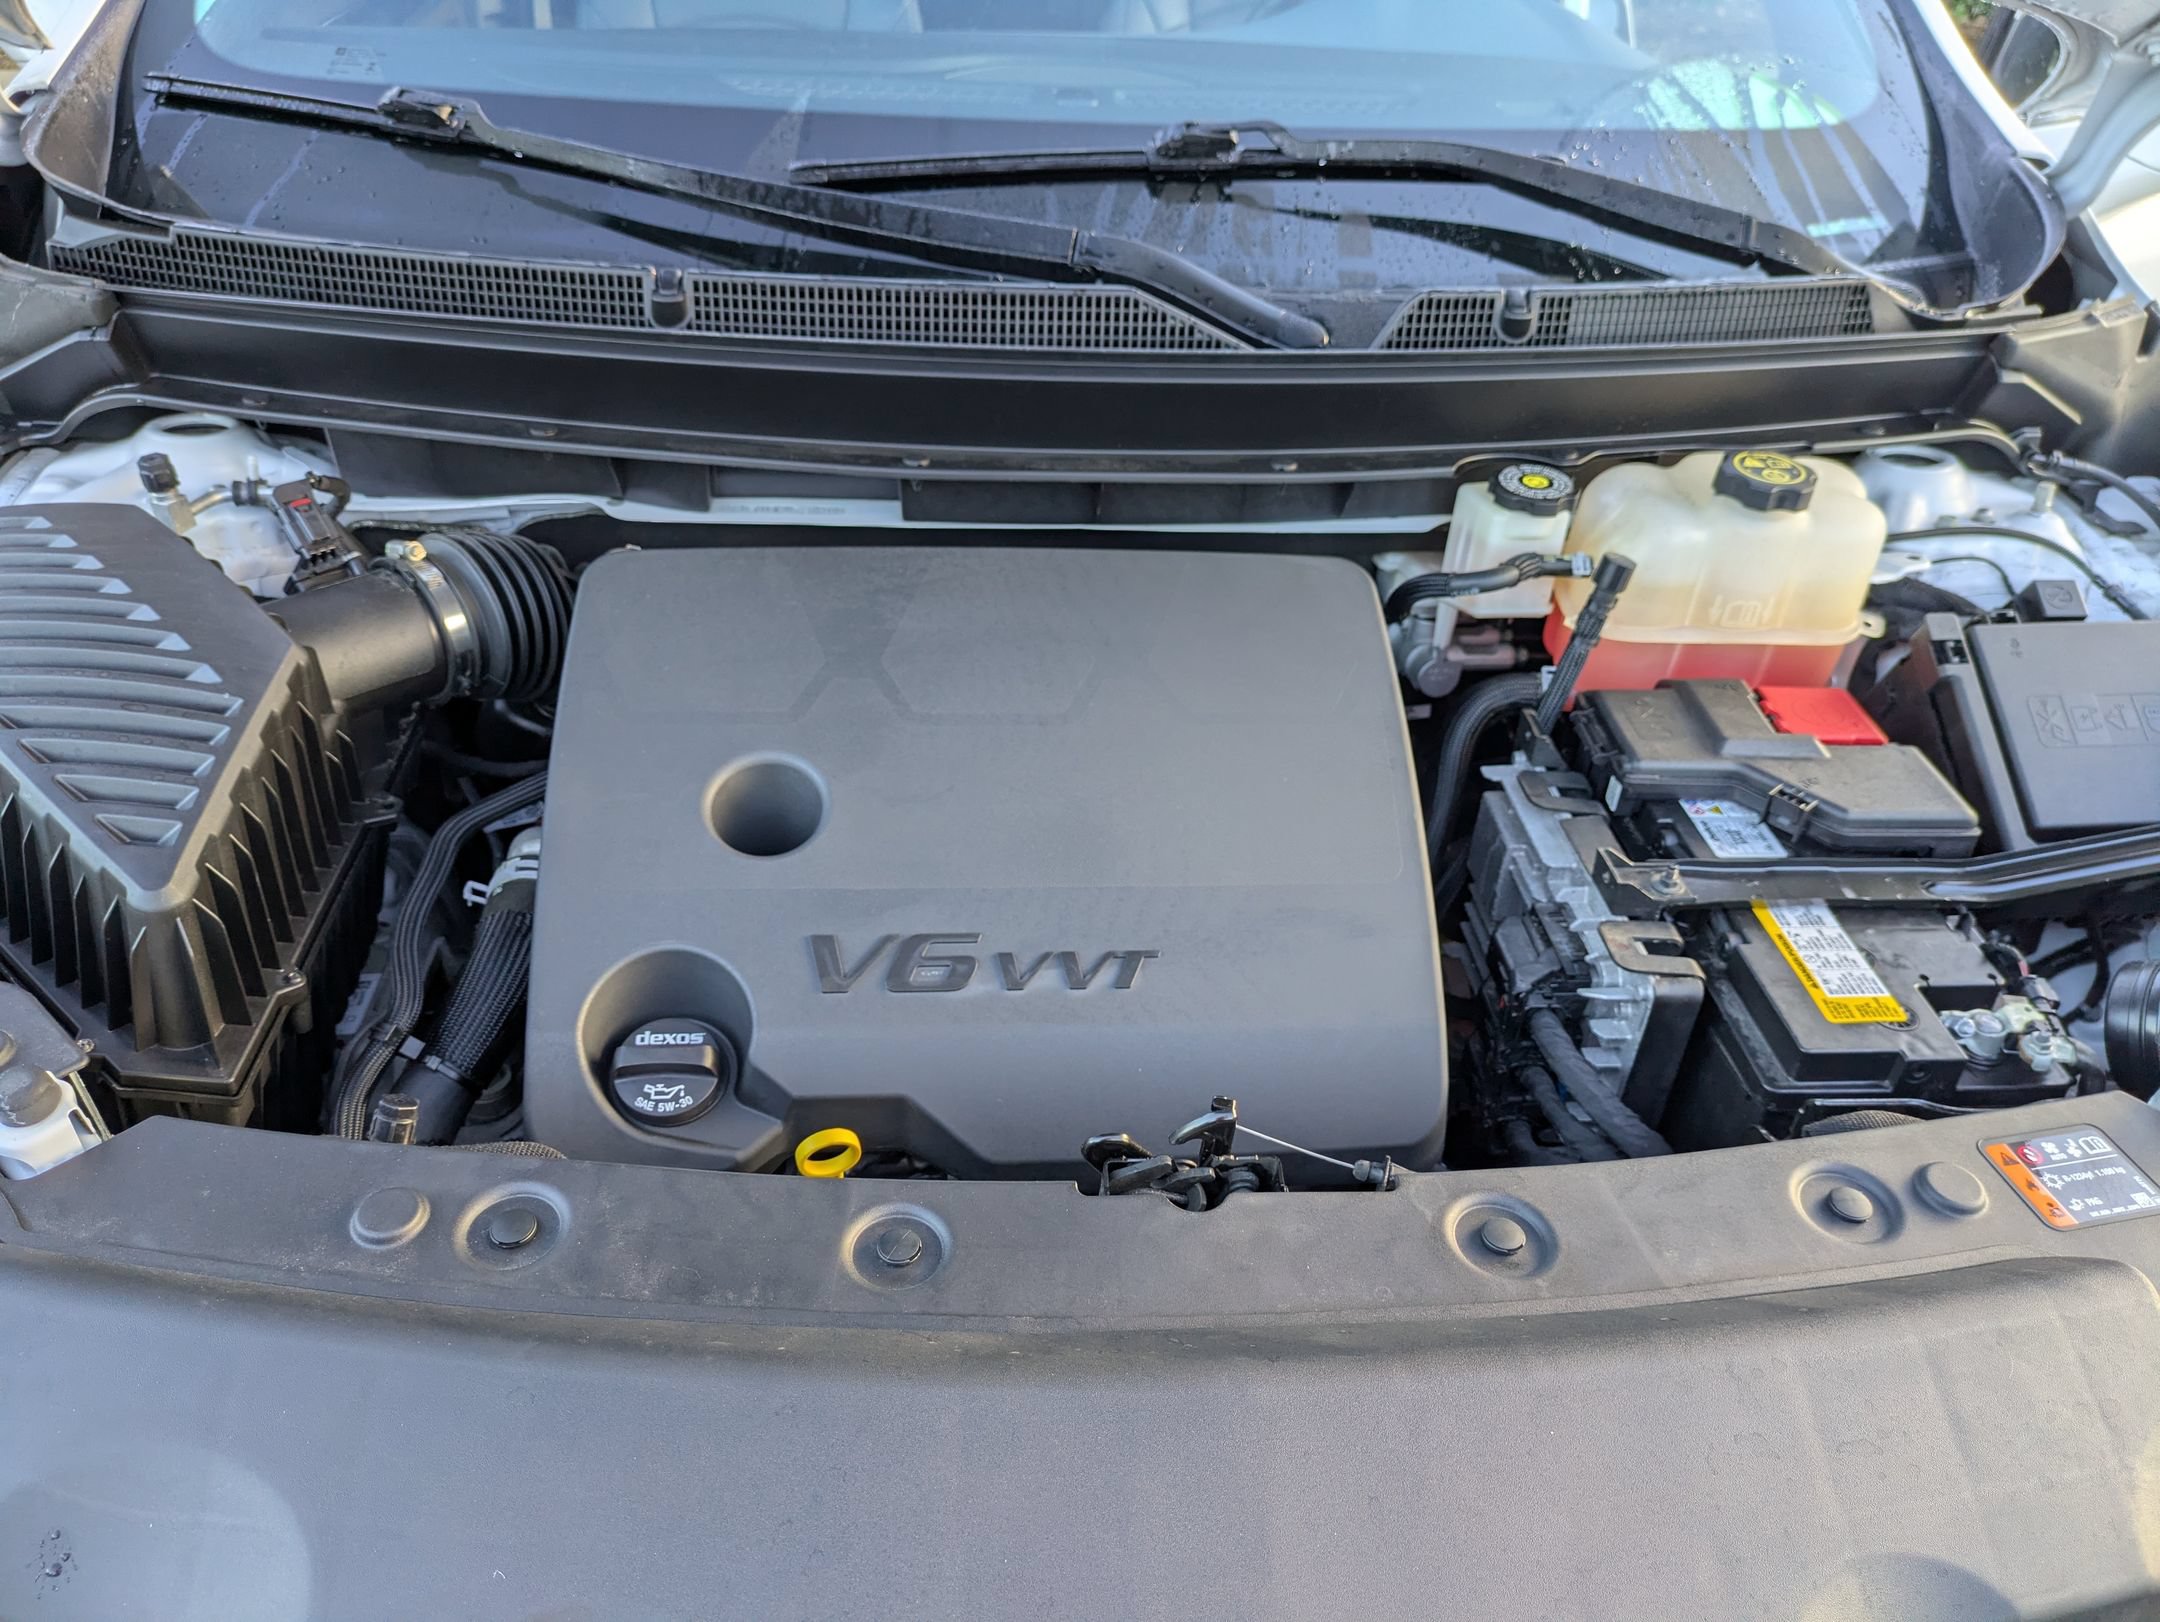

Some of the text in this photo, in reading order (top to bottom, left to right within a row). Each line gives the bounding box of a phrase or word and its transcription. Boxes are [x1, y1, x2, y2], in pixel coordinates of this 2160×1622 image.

[809, 932, 1161, 994] V6 VVT
[635, 1031, 706, 1046] dexos
[634, 1096, 694, 1112] SAE 5W-30
